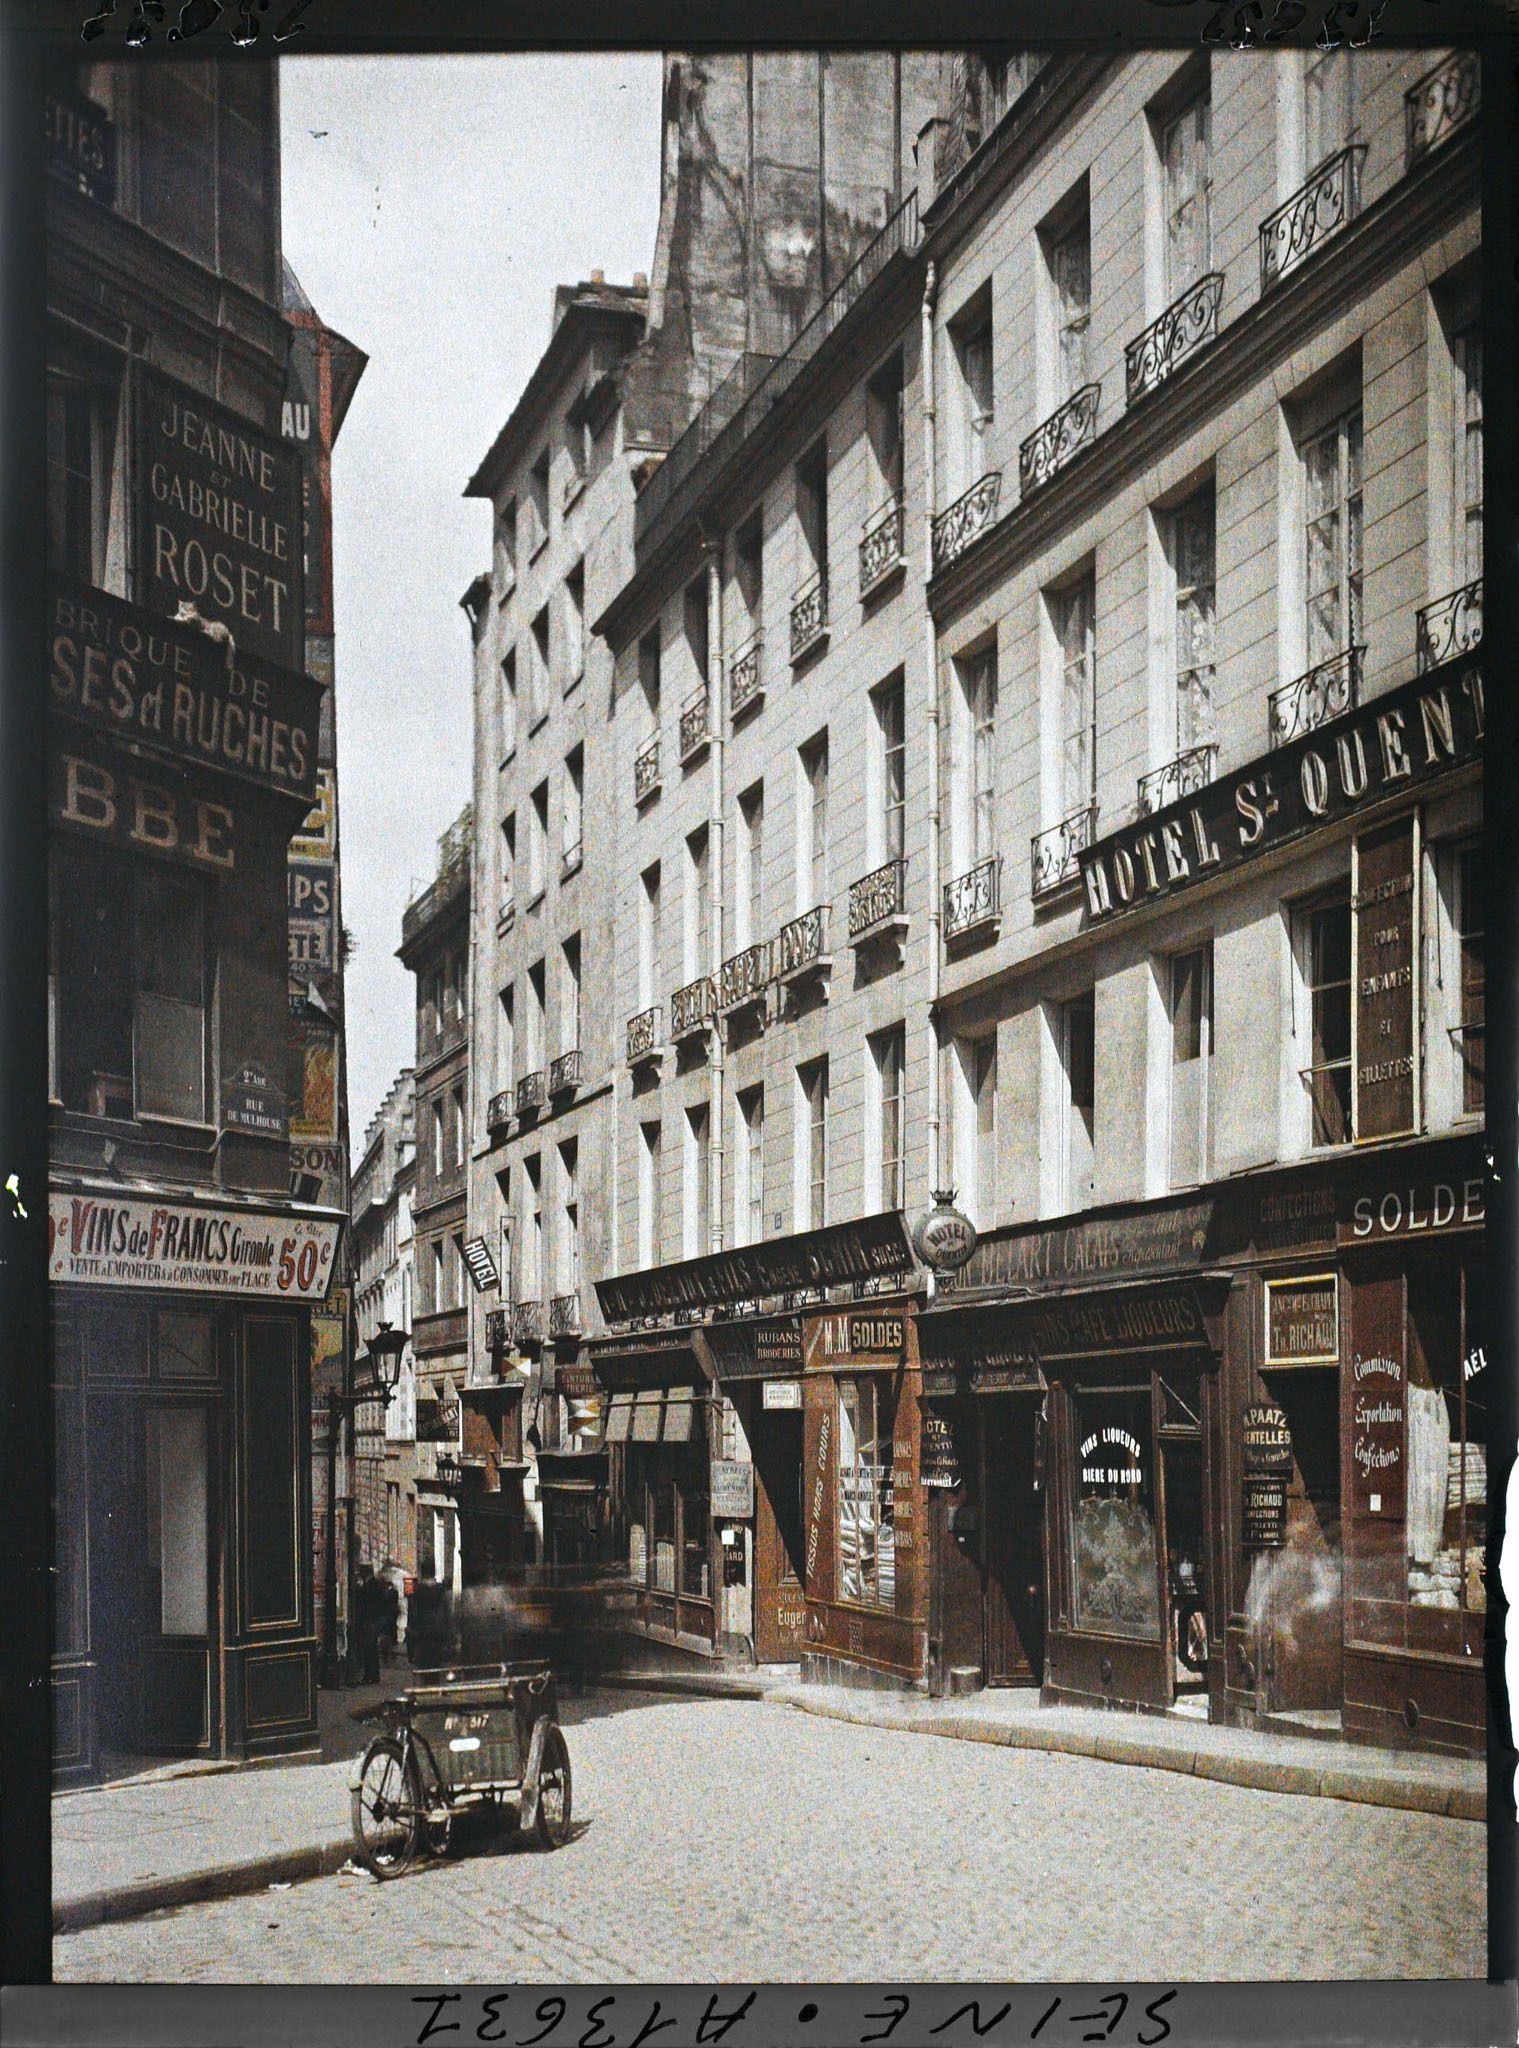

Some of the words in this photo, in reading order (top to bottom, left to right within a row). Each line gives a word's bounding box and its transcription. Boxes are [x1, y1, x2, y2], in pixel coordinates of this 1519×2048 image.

[281, 401, 310, 440] AU
[161, 403, 276, 493] JEANNE
[151, 462, 288, 562] GABRIELLE
[155, 523, 288, 634] ROSET
[229, 670, 270, 708] DE
[1374, 926, 1400, 946] POUR
[1361, 965, 1411, 996] ENFANTS
[1358, 1054, 1414, 1085] FILLETTES
[227, 1110, 239, 1122] DE
[240, 1112, 283, 1130] MULHOUSE
[245, 1098, 265, 1113] RUE
[1353, 1178, 1486, 1237] SOLDE
[70, 1198, 131, 1257] VINS
[127, 1220, 149, 1258] de
[230, 1226, 275, 1269] Gironde
[926, 1222, 967, 1248] HOTEL
[70, 1257, 100, 1276] VENTE
[107, 1260, 161, 1281] EMPORTER
[464, 1239, 497, 1290] HOTEL
[757, 1332, 801, 1344] RUBANS
[852, 1321, 903, 1349] SOLDES
[757, 1347, 801, 1361] BRODERIES
[1354, 1351, 1401, 1381] Commission
[1355, 1396, 1403, 1433] Exportation
[818, 1413, 831, 1472] COURS
[1080, 1433, 1098, 1459] VINS
[1102, 1427, 1141, 1458] LIQUEURS
[1107, 1467, 1119, 1484] DU
[1120, 1467, 1142, 1485] NORD
[811, 1475, 825, 1522] HORS
[806, 1523, 820, 1579] TISSUS
